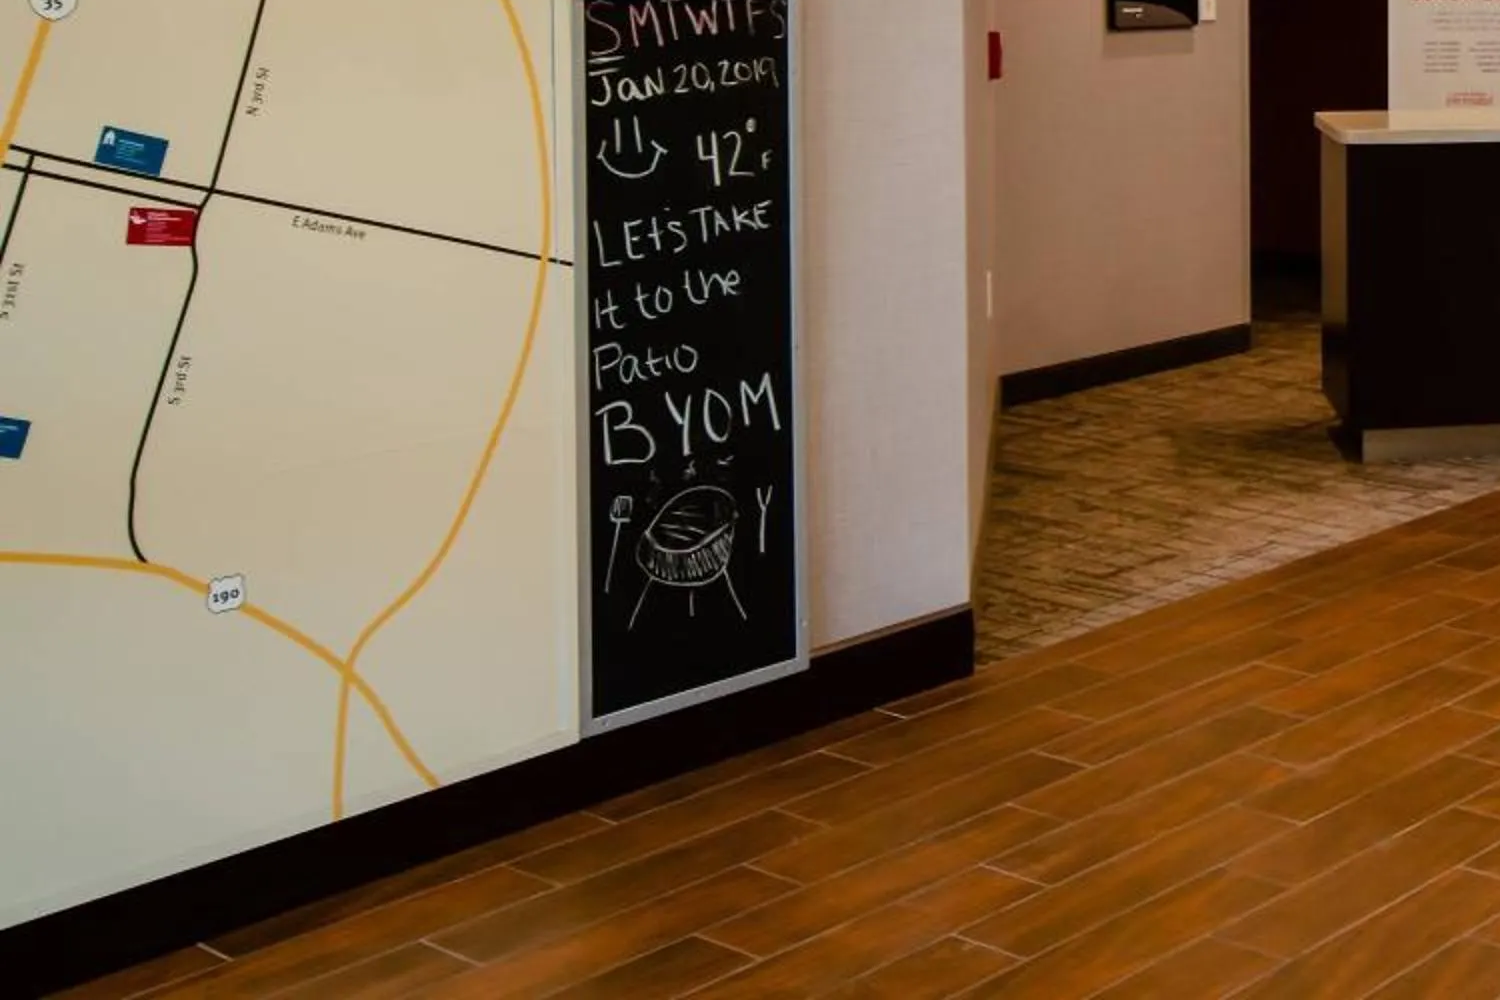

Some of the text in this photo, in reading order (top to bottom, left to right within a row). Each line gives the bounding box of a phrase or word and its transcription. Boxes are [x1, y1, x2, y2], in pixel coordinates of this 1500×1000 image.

[689, 200, 772, 244] TAKE
[635, 282, 673, 319] to
[683, 269, 741, 304] the
[592, 341, 698, 390] Patio
[595, 372, 781, 466] BYOM
[213, 588, 240, 605] 190
